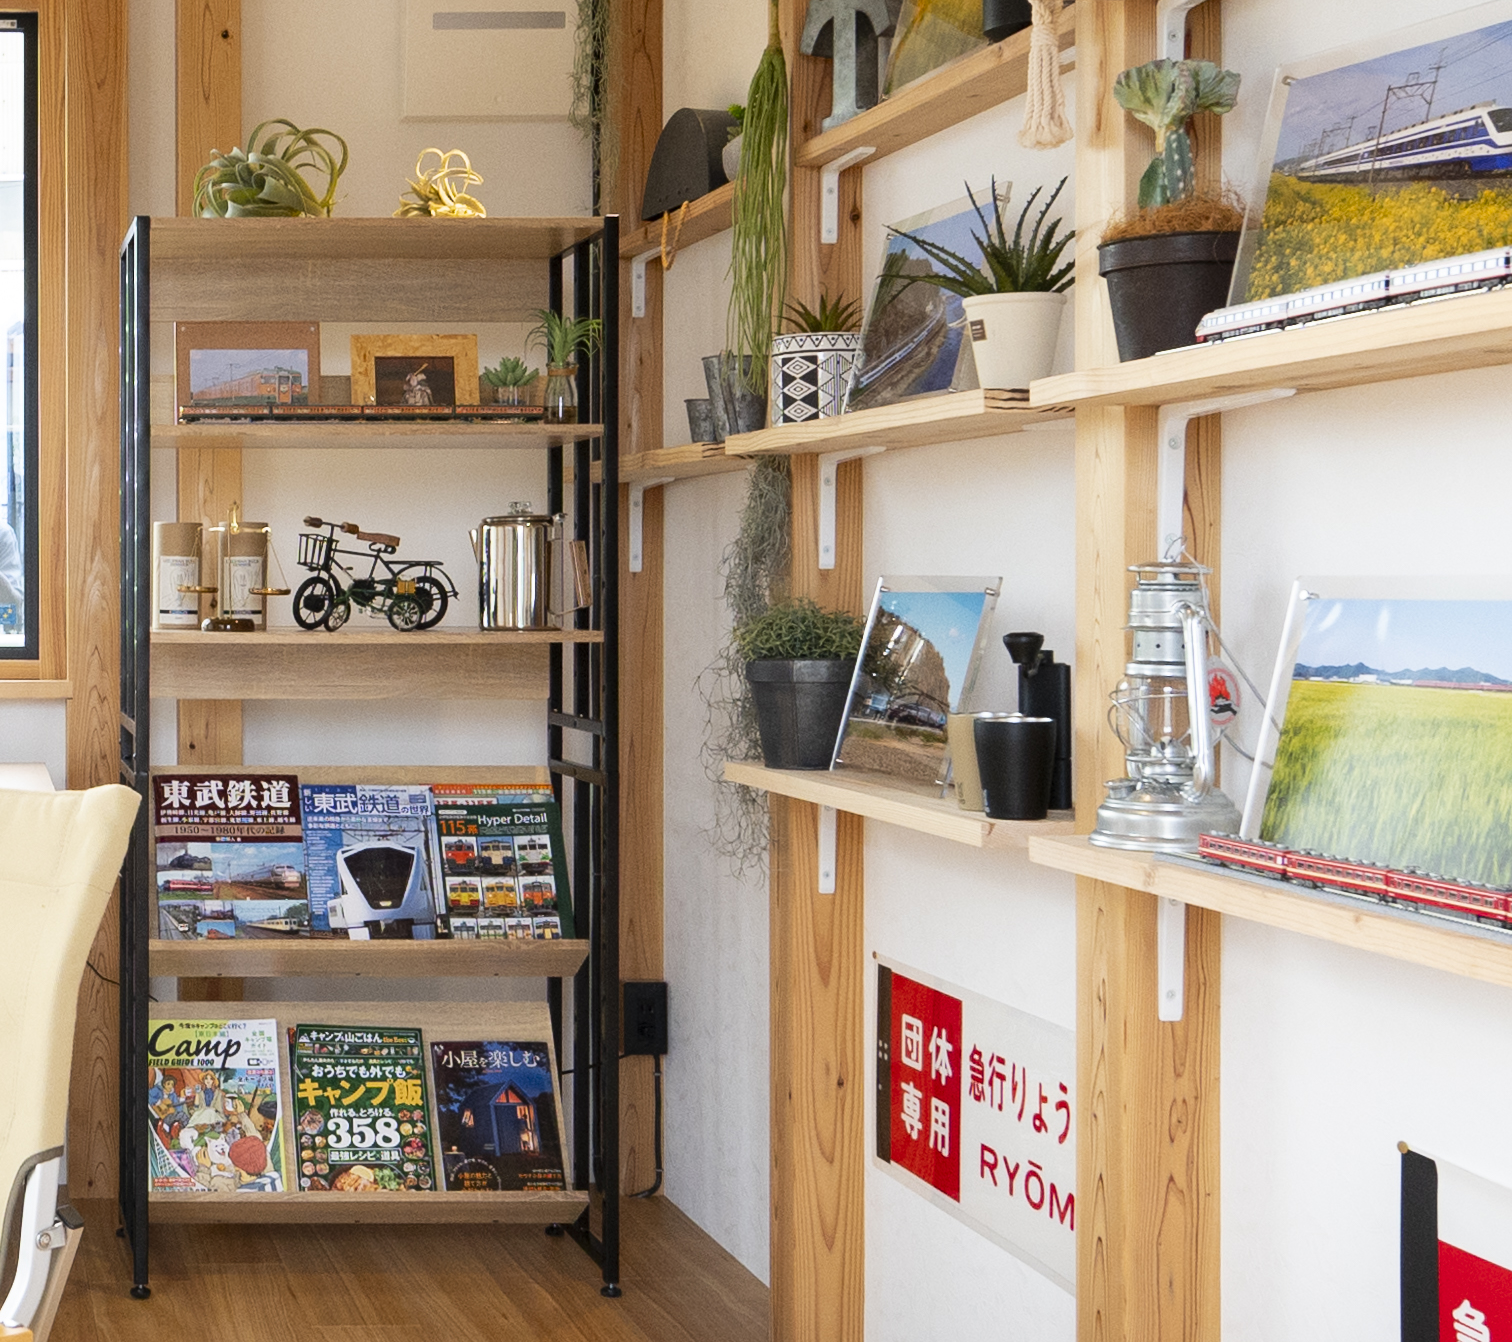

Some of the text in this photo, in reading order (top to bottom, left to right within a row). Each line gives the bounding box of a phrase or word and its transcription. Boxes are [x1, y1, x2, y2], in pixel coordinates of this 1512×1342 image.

[161, 780, 292, 808] 東武鉄道
[478, 815, 512, 827] Hyper
[513, 813, 548, 824] Detail
[148, 1023, 242, 1070] Camp
[441, 1050, 541, 1068] 小屋を楽しむ
[901, 1013, 953, 1086] 団体
[149, 1059, 170, 1067] FIELD
[171, 1059, 195, 1067] GUIDE
[312, 1065, 406, 1078] おうちでも外でも
[298, 1078, 424, 1106] キャンプ飯
[968, 1043, 1072, 1145] 急行りょう
[327, 1117, 401, 1148] 358
[901, 1081, 950, 1158] 専用
